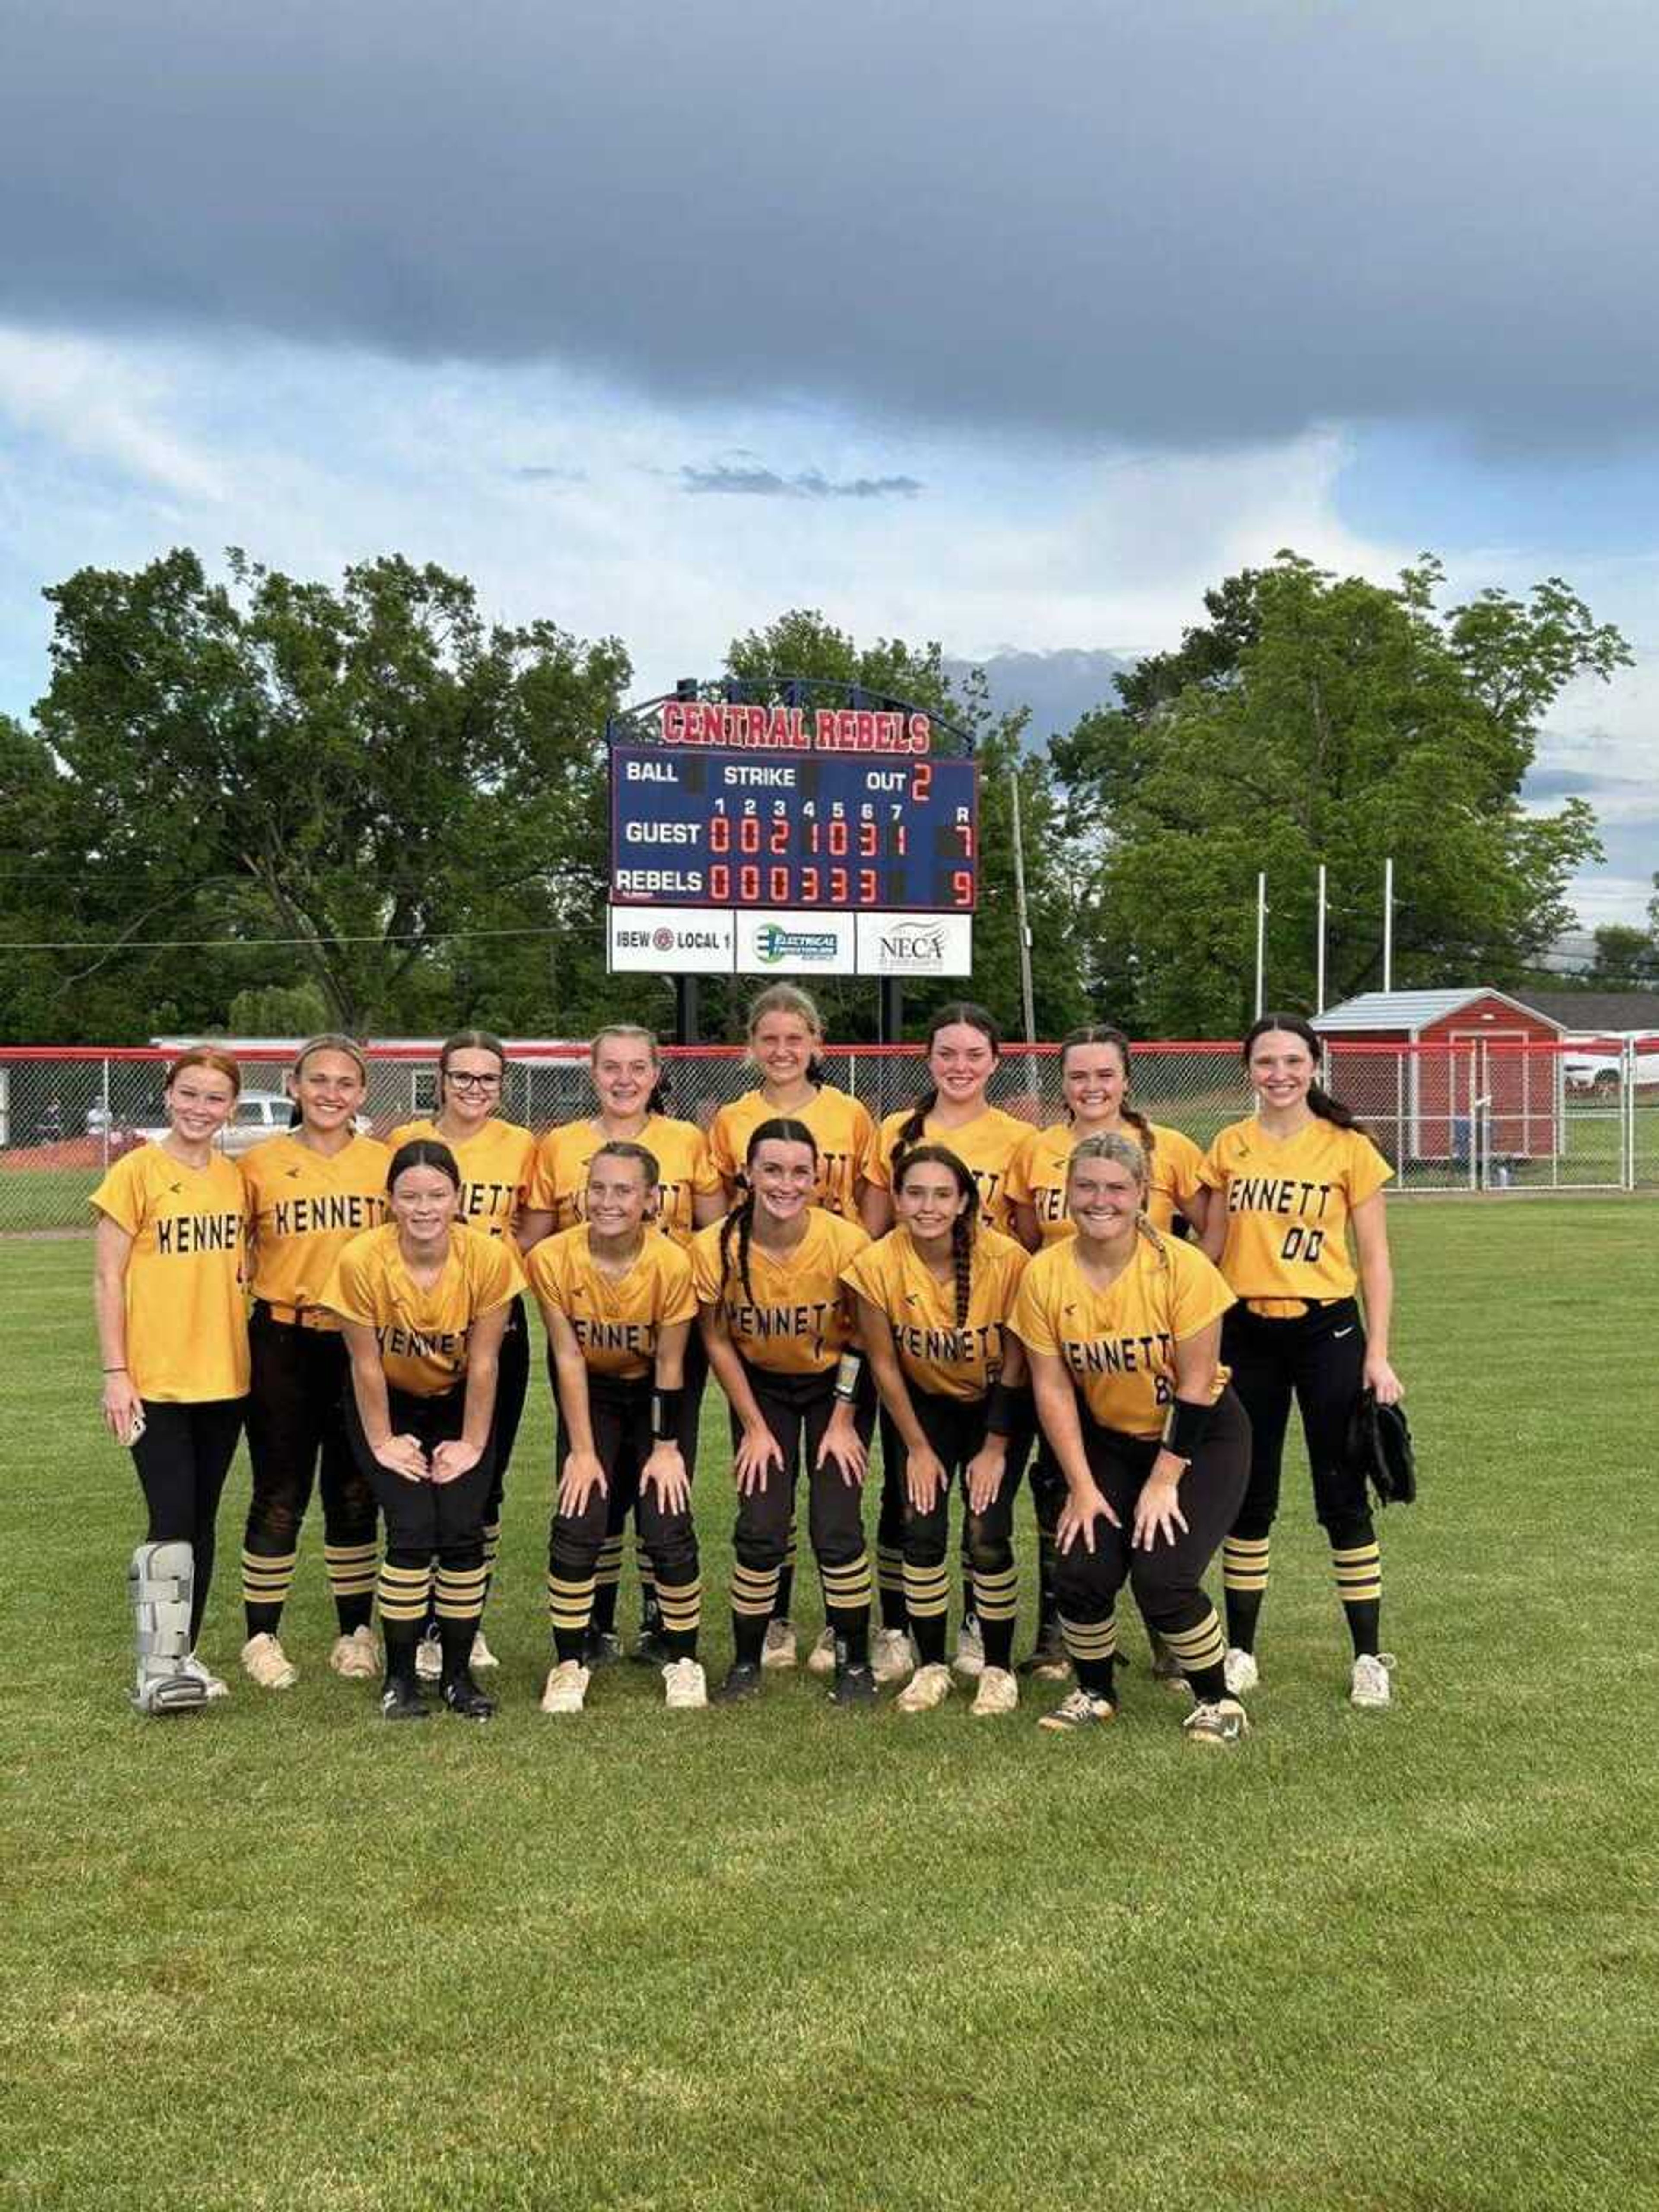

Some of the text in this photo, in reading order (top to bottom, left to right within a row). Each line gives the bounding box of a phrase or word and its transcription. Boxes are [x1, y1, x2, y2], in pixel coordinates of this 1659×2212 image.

[662, 701, 930, 754] CENTRAL REBELS
[627, 762, 931, 801] BALL STRIKE OUT 2
[715, 798, 969, 823] 1 2 3 4 5 6 7 R
[626, 818, 971, 857] GUEST 0 0 2 1 0 3 1 7
[617, 865, 971, 904] REBELS 0 0 0 3 3 3 9
[617, 931, 730, 949] IBEW LOCAL 1
[879, 935, 943, 959] NECA
